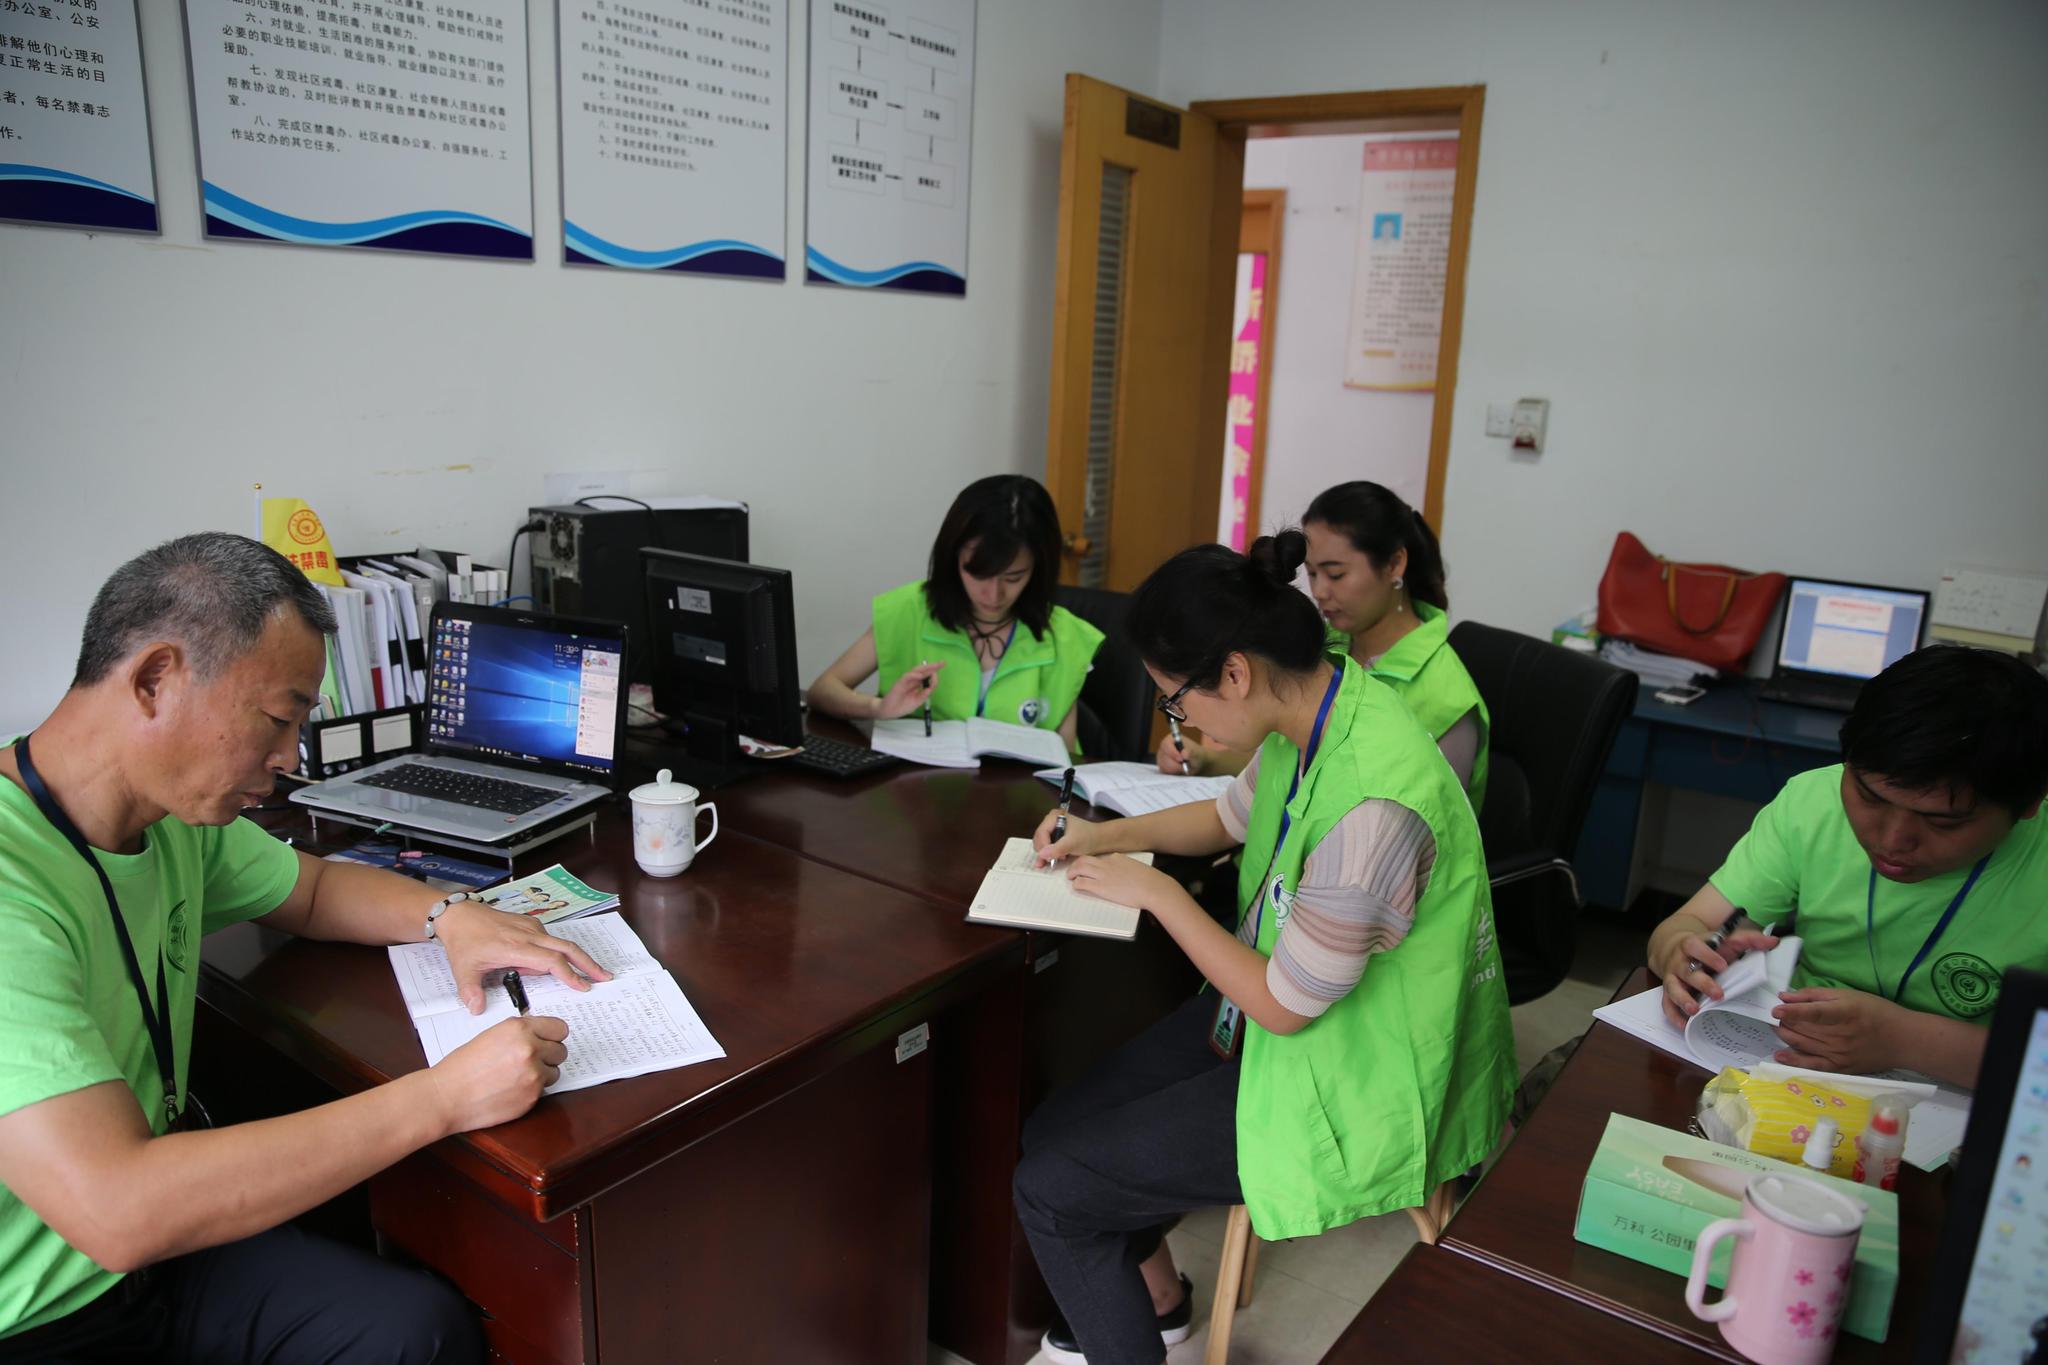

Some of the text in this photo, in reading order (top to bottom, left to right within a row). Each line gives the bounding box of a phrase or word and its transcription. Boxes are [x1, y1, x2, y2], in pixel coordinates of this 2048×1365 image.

[0, 0, 99, 28] 办公室、公安
[54, 0, 97, 10] 议的
[0, 91, 110, 118] 者，每名禁毒志
[1613, 1215, 1644, 1236] 万科
